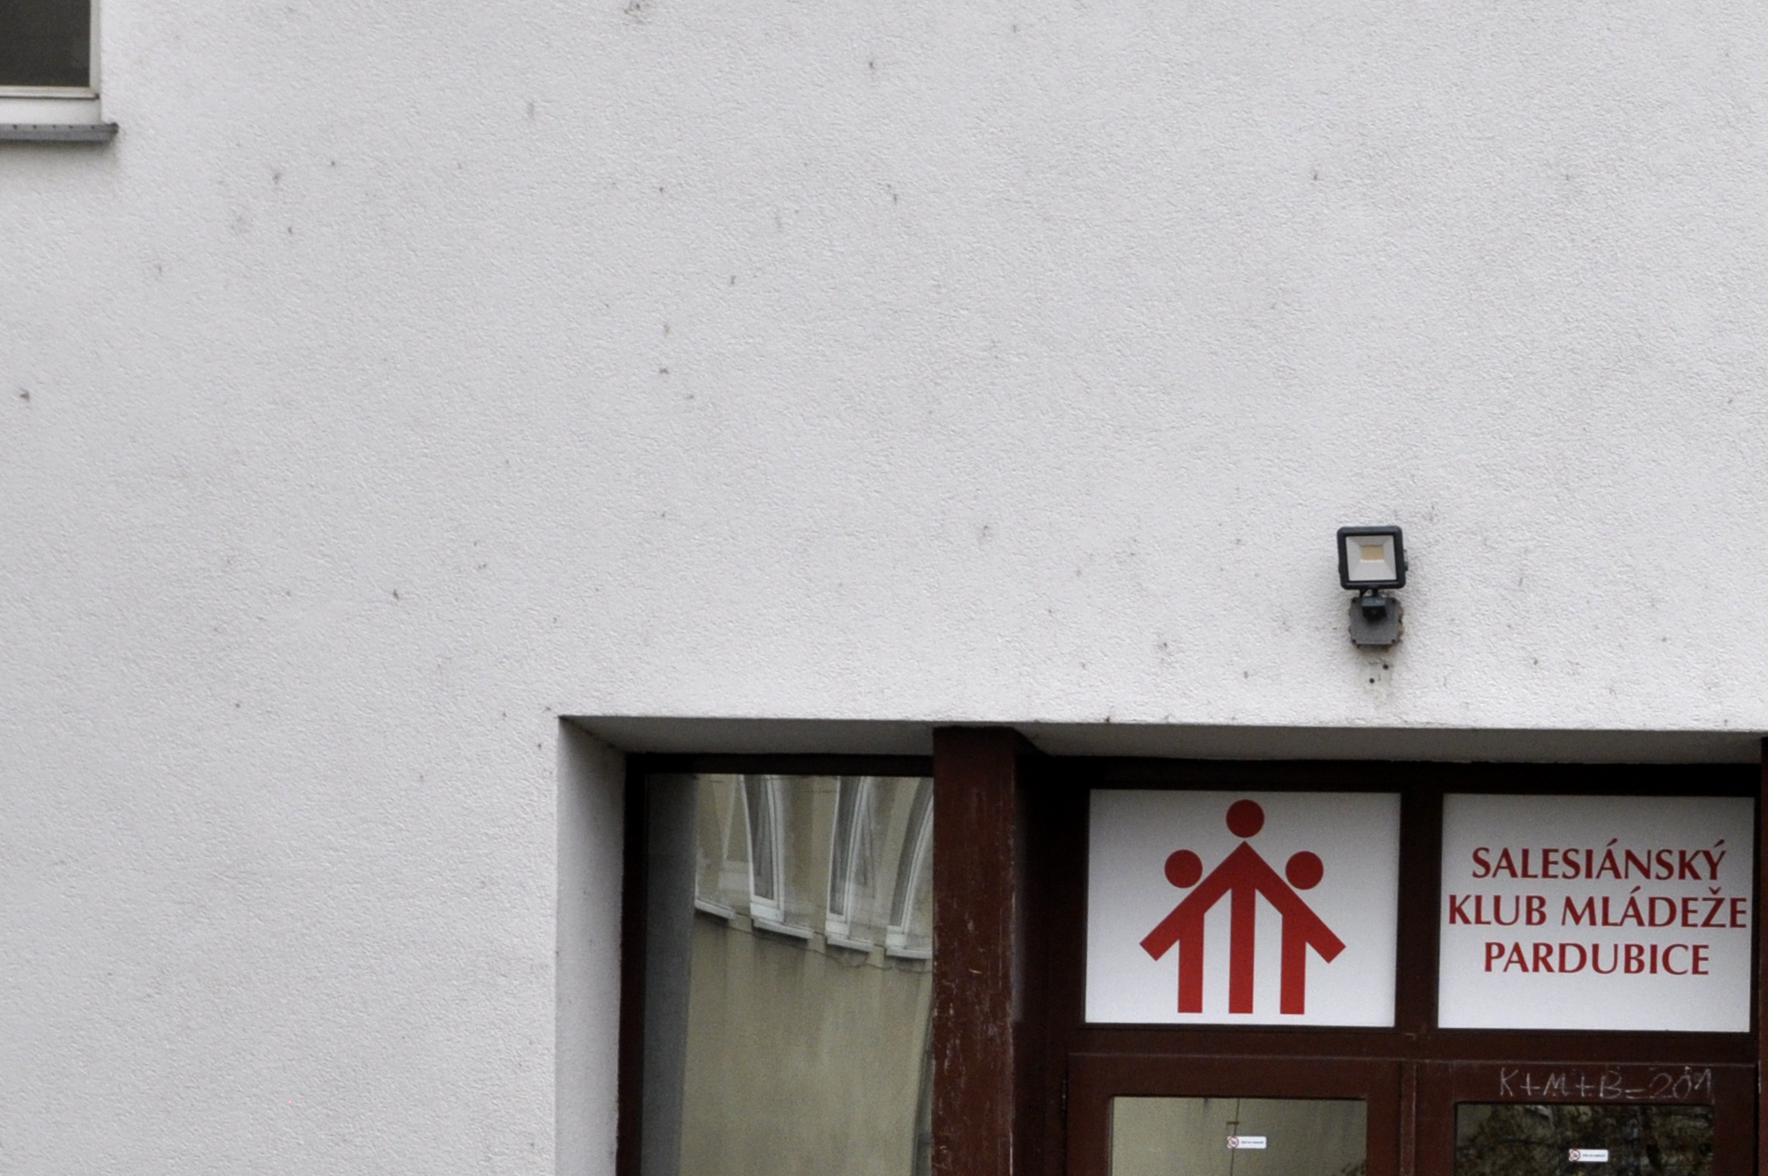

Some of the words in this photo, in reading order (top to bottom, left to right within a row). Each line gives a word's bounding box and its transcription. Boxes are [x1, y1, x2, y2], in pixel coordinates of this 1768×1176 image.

[1471, 838, 1726, 881] SALESIÁNSKÝ
[1448, 894, 1548, 927] KLUB
[1561, 885, 1747, 928] MLÁDEŽE
[1483, 941, 1710, 976] PARDUBICE
